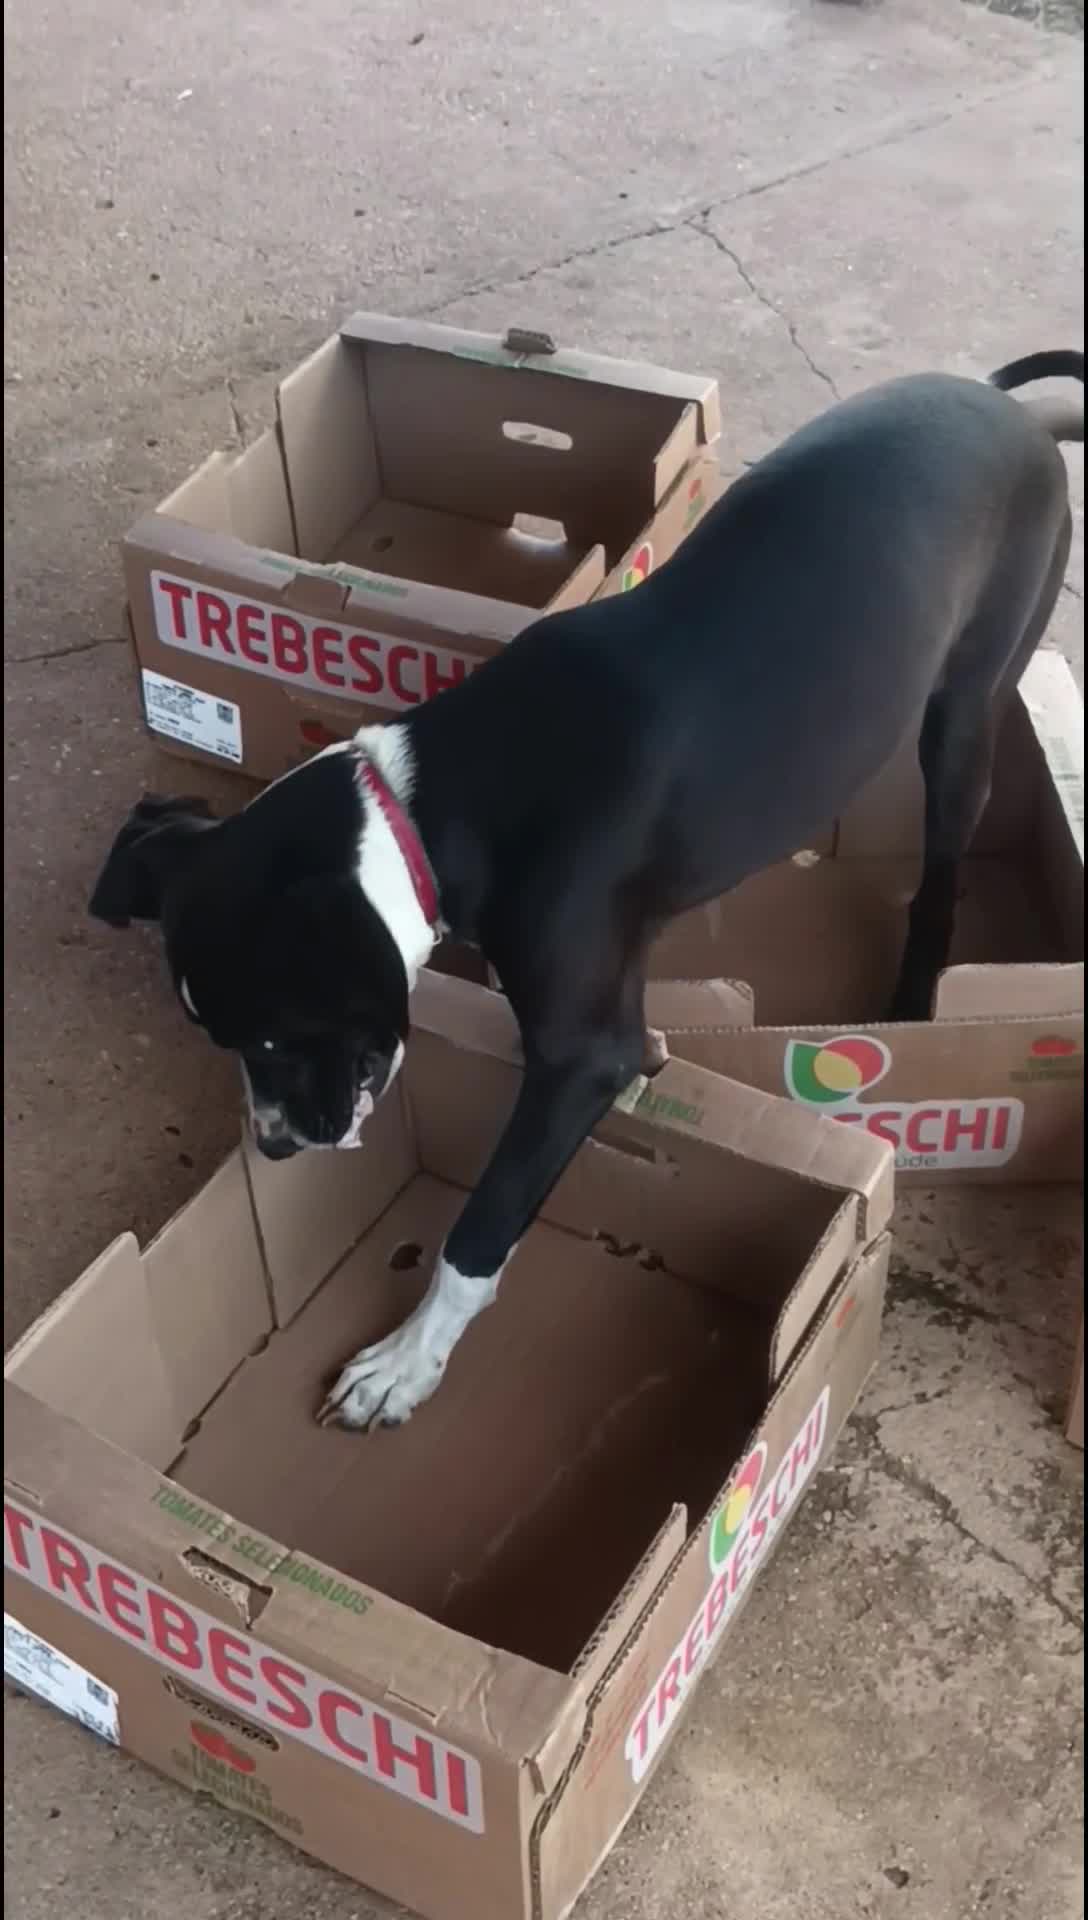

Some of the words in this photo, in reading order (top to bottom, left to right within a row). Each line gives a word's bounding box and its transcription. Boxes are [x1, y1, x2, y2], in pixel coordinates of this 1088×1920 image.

[159, 579, 475, 703] TREBESCH
[832, 1107, 1010, 1153] SCHI
[151, 1484, 236, 1543] TOMATES
[633, 1402, 822, 1760] TREBESCHI
[4, 1504, 468, 1816] TREBESCHI
